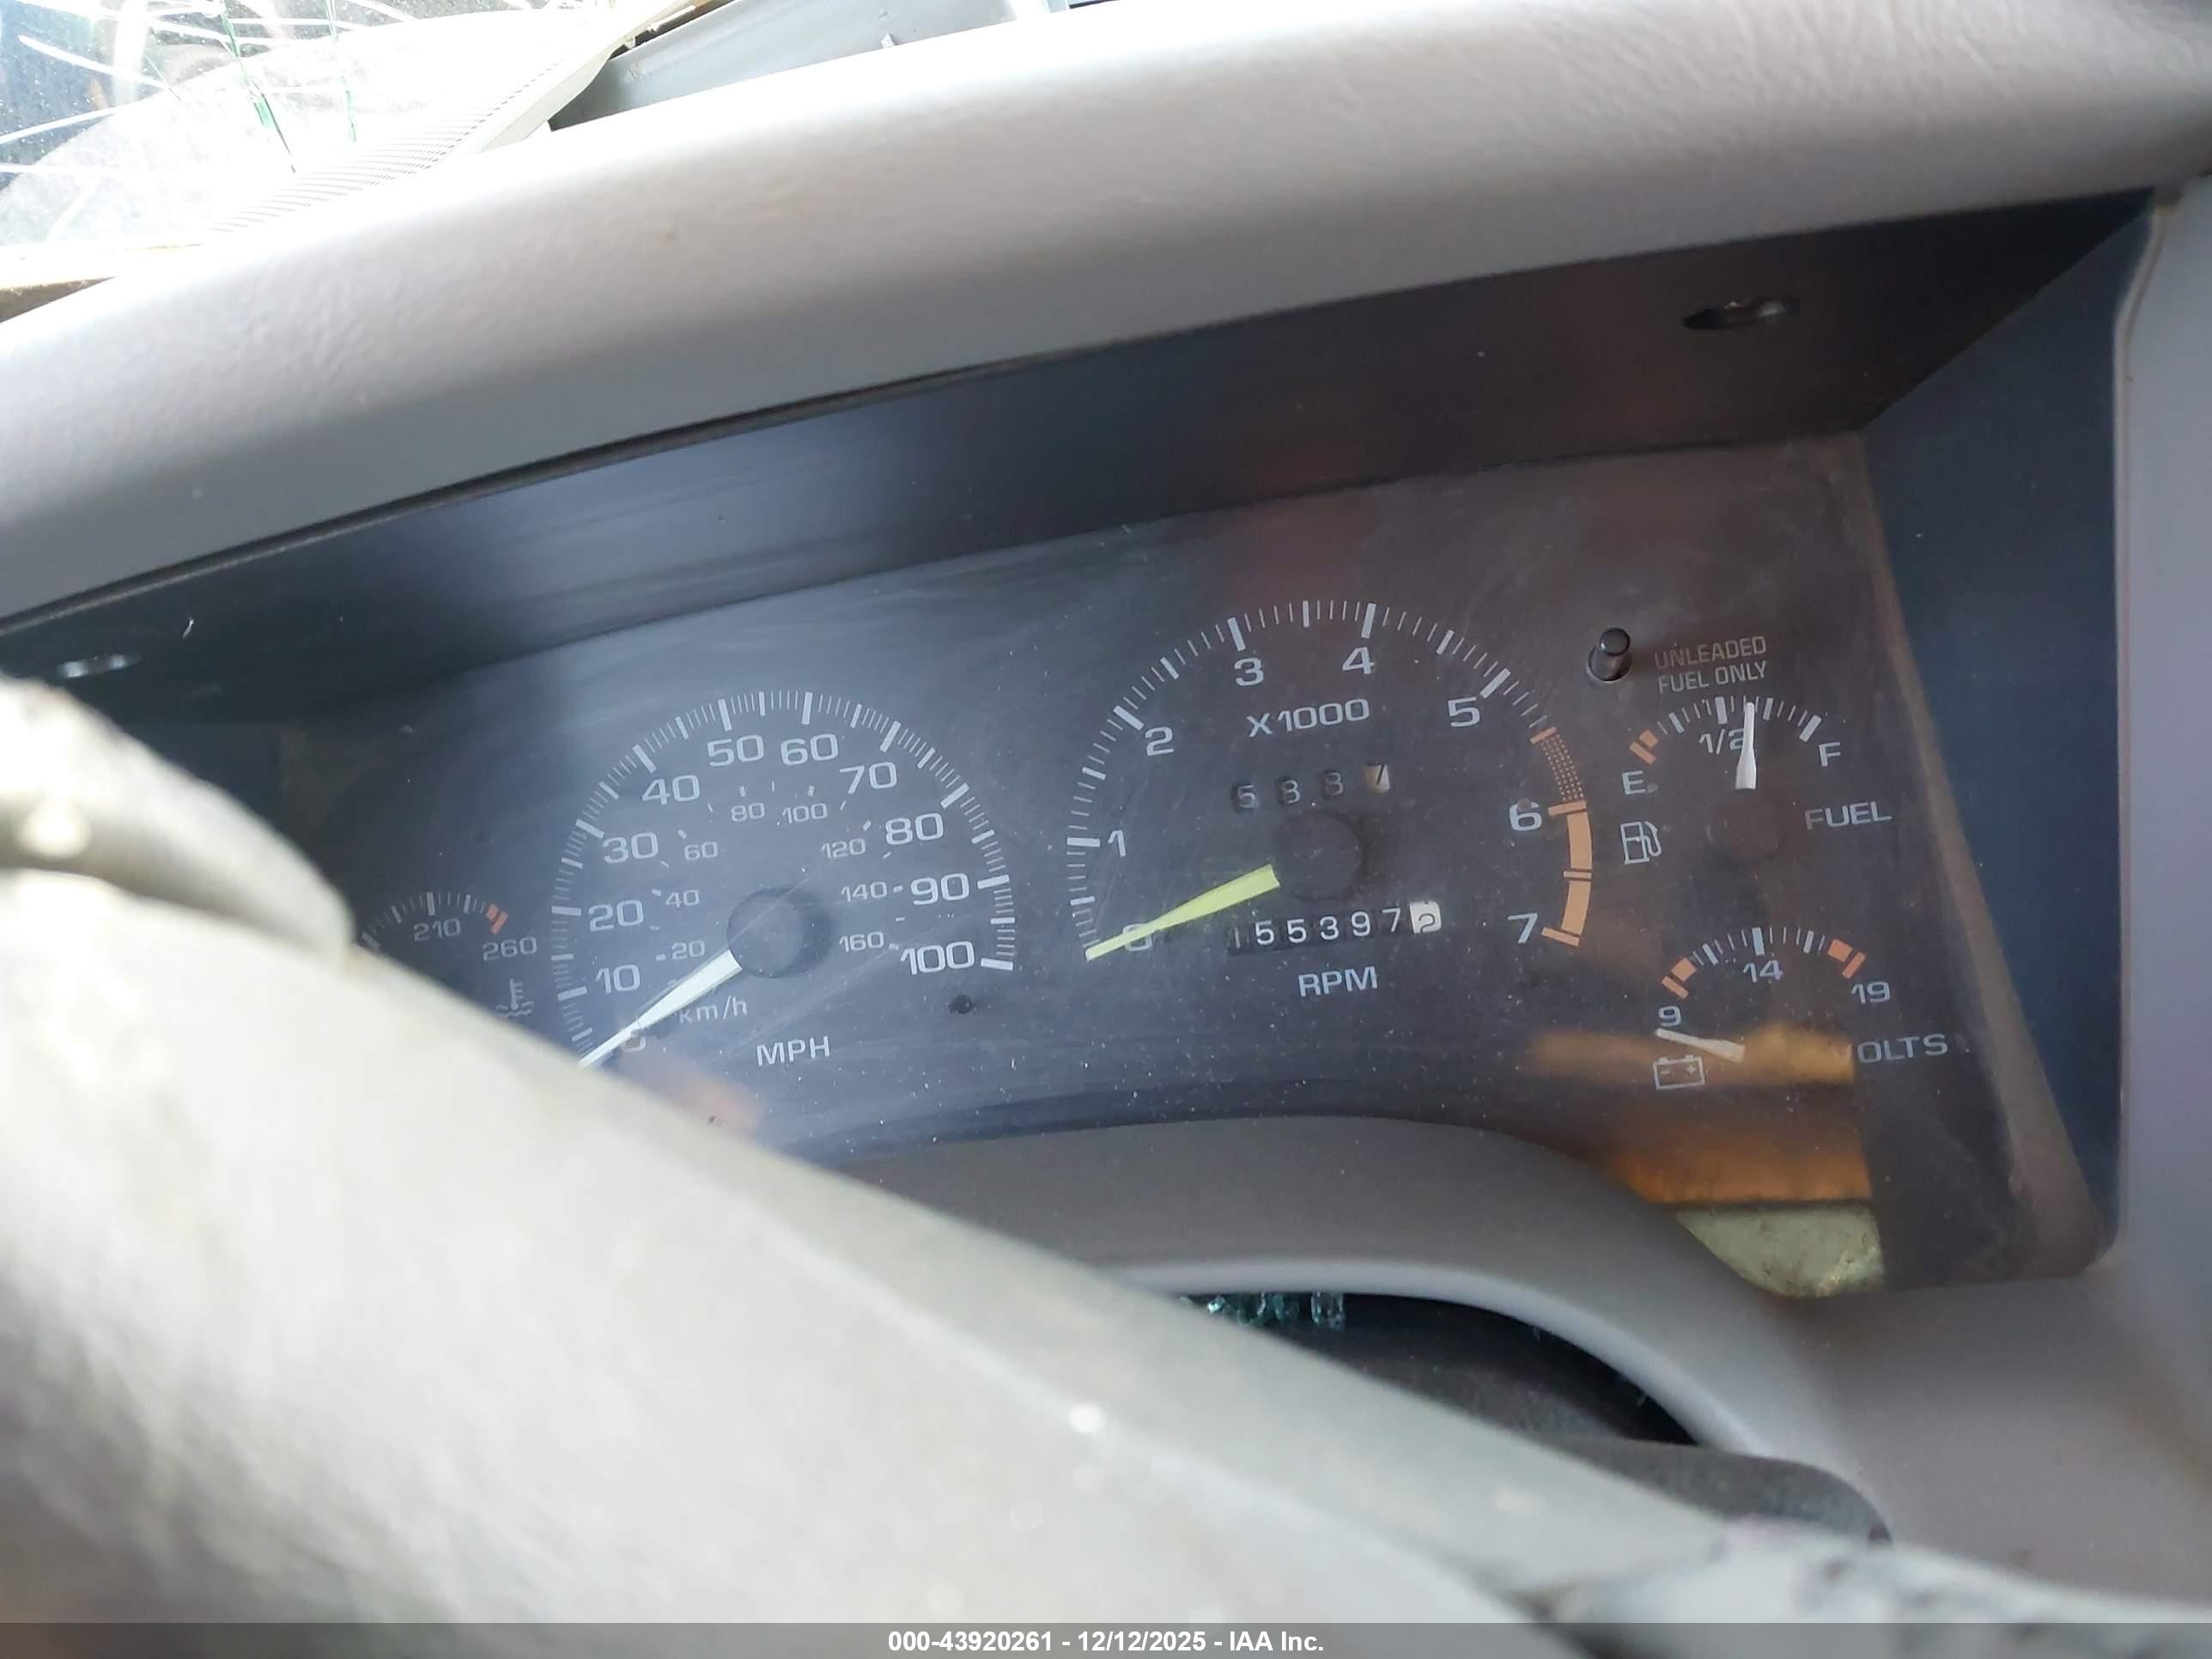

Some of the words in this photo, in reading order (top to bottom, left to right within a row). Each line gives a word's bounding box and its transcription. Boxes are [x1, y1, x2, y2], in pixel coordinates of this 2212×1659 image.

[1342, 647, 1374, 675] 4
[1655, 635, 1767, 669] UNLEADED
[1234, 657, 1264, 686] 3
[1658, 669, 1710, 695] FUEL
[1714, 660, 1768, 687] ONLY
[1246, 699, 1370, 738] X1000
[1448, 696, 1481, 727] 5
[707, 735, 764, 767] 50
[781, 733, 839, 766] 60
[1146, 726, 1174, 757] 2
[1819, 742, 1842, 767] F
[641, 775, 700, 805] 40
[839, 761, 898, 794] 70
[1622, 770, 1645, 796] E
[731, 802, 765, 822] 80
[782, 803, 828, 824] 100
[1510, 800, 1542, 831] 6
[1805, 801, 1893, 830] FUEL
[884, 811, 945, 844] 80
[603, 832, 658, 863] 30
[684, 842, 719, 860] 60
[821, 838, 866, 860] 120
[1108, 830, 1127, 857] 1
[665, 890, 701, 908] 40
[841, 882, 887, 901] 140
[910, 872, 970, 905] 90
[588, 899, 644, 932] 20
[1508, 913, 1539, 944] 7
[413, 919, 461, 942] 210
[838, 932, 884, 951] 160
[483, 936, 538, 961] 260
[672, 940, 705, 959] 20
[900, 941, 974, 975] 100
[595, 964, 641, 994] 10
[1297, 966, 1378, 998] RPM
[1742, 960, 1784, 984] 14
[1850, 981, 1891, 1005] 19
[679, 995, 748, 1024] km/h
[1658, 1006, 1681, 1027] 9
[757, 1036, 830, 1066] MPH
